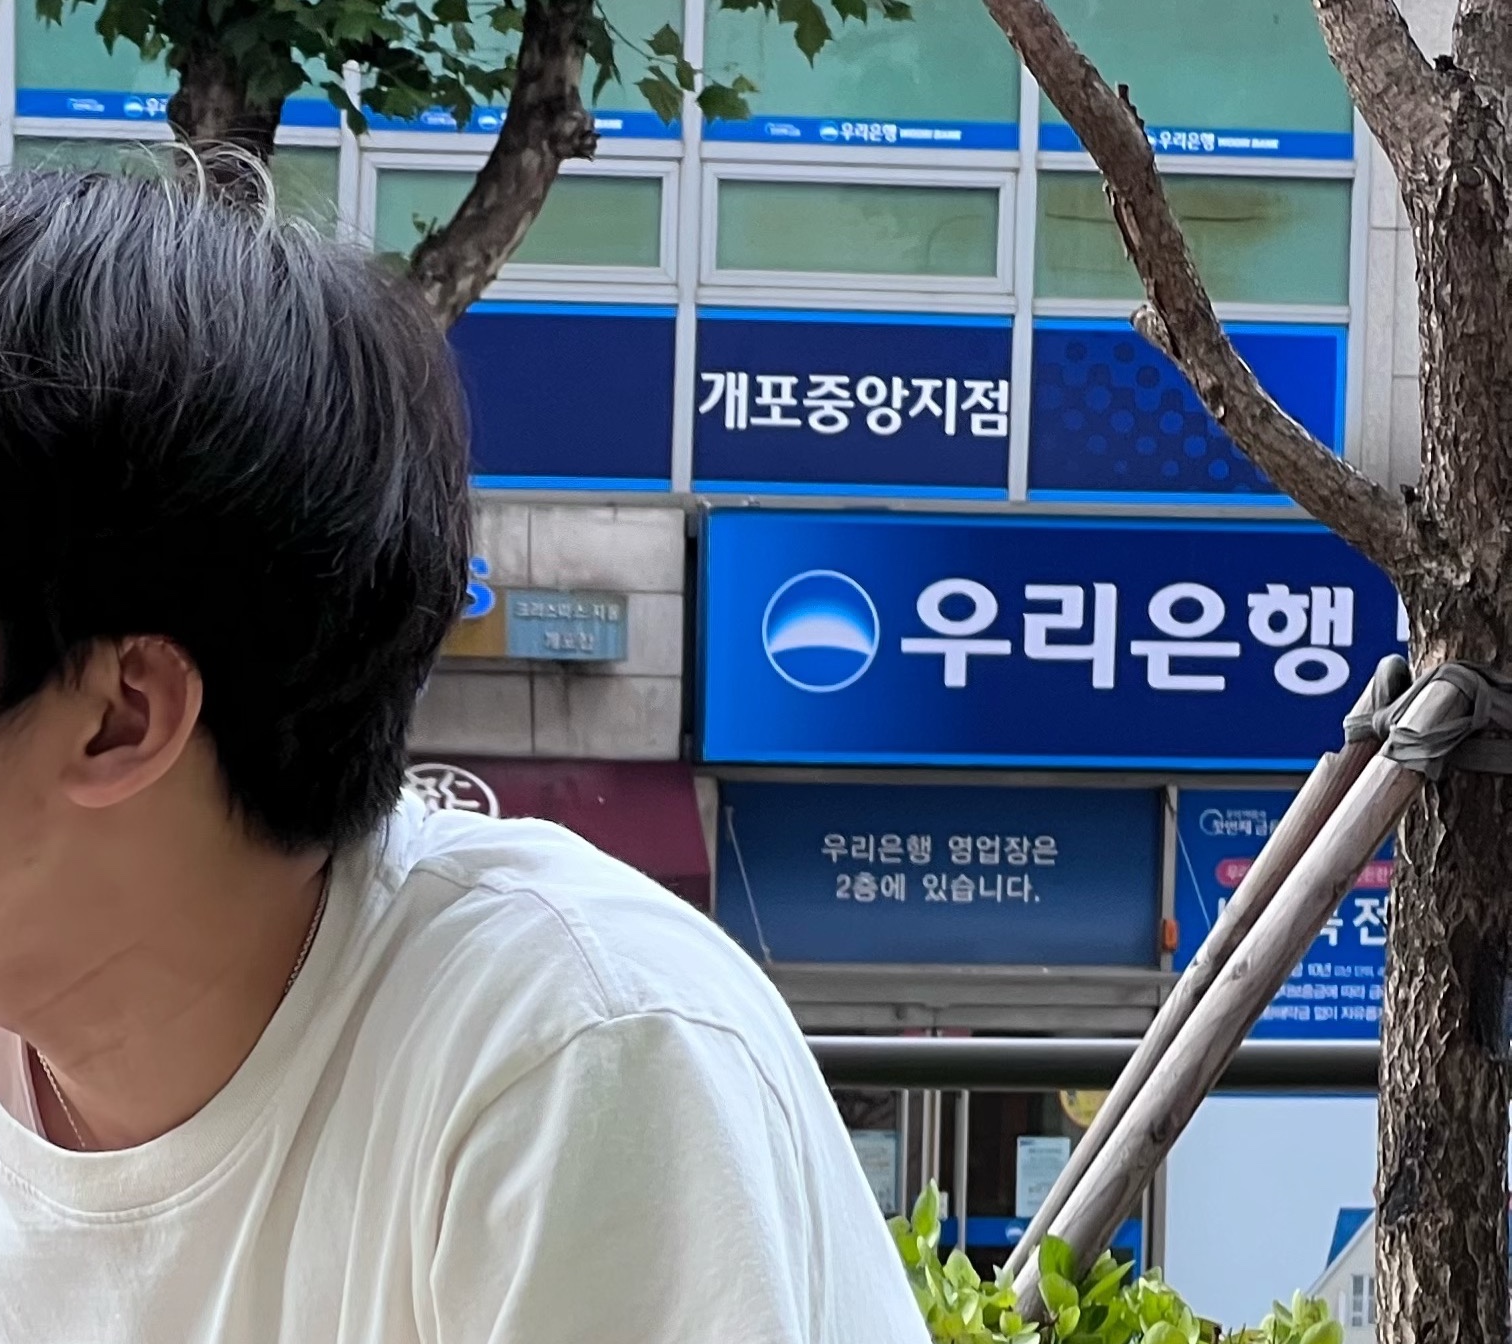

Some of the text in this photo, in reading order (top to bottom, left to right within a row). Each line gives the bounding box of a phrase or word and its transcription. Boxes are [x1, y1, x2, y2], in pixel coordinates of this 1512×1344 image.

[699, 371, 1010, 438] 개포중앙지점
[900, 577, 1355, 696] 우리은행
[821, 833, 1059, 866] 우리은행 영업장은
[836, 872, 1040, 903] 2층에 있습니다.
